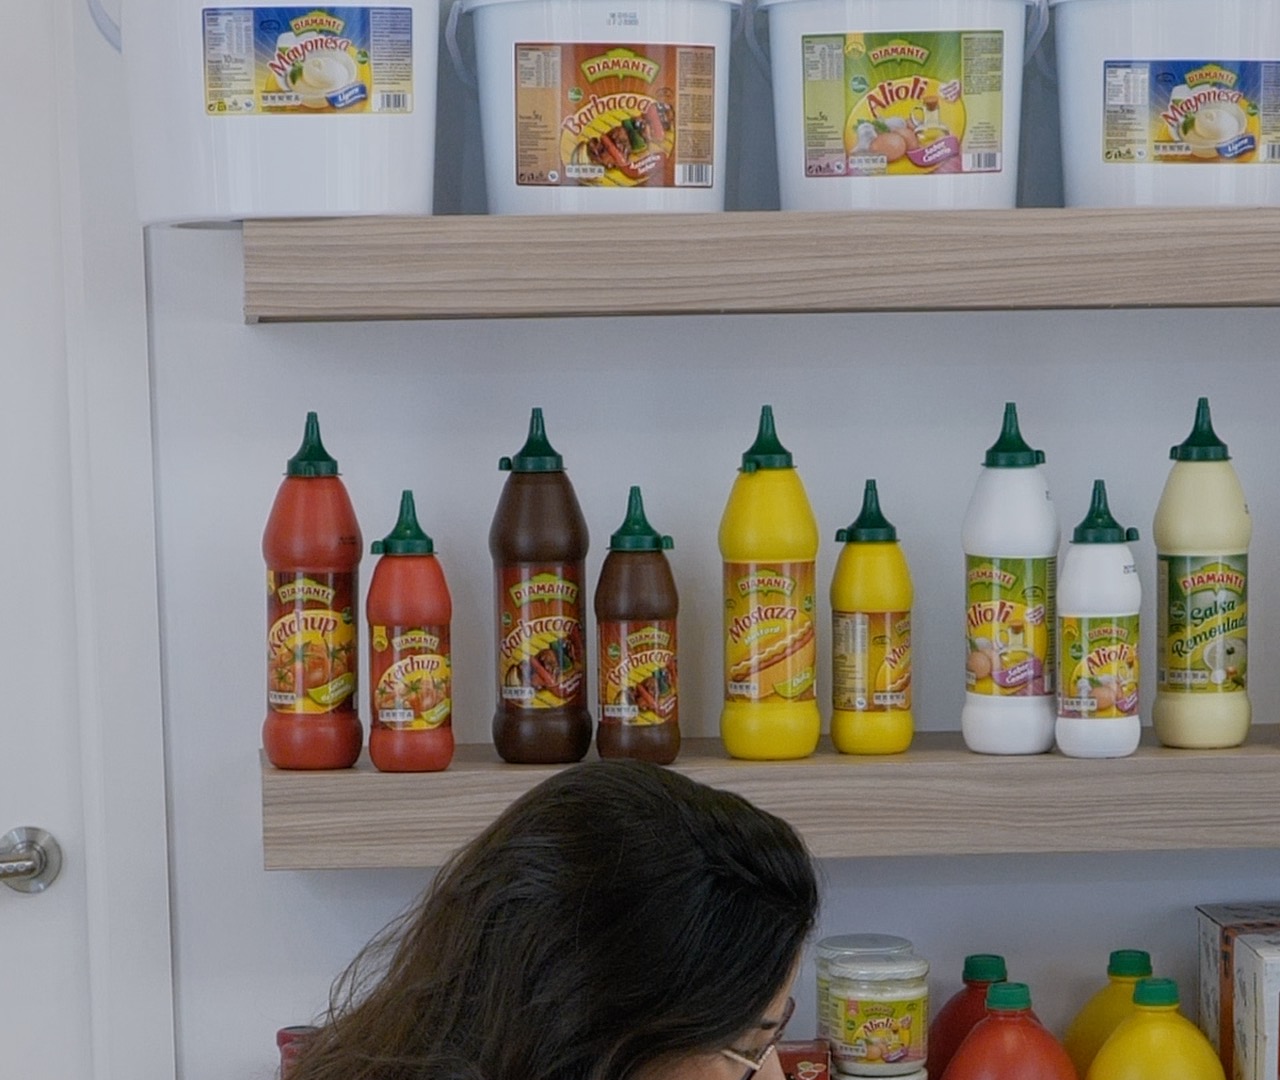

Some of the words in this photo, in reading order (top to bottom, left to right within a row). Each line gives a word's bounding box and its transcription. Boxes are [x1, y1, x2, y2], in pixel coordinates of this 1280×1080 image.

[294, 17, 342, 31] DIAMANTE
[268, 36, 351, 77] Mayonesa
[587, 59, 654, 76] DIAMANTE
[872, 47, 926, 61] DIAMANTE
[1188, 72, 1234, 84] DIAMANTE
[866, 77, 928, 120] Alioli
[1162, 89, 1243, 127] Mayonesa
[563, 94, 650, 136] Barbacoa
[281, 586, 332, 599] DIAMANTE
[515, 583, 576, 600] DIAMANTE
[740, 577, 792, 591] DIAMANTE
[1183, 572, 1244, 589] DIAMANTE
[728, 606, 797, 643] Mostaza
[1190, 600, 1235, 627] Salsa
[270, 611, 337, 656] Ketchup
[501, 617, 575, 659] Barbacoa
[630, 634, 668, 645] DIAMANTE
[383, 655, 439, 690] Ketchup
[609, 652, 670, 685] Barbacoa
[1086, 644, 1130, 675] Alioli
[863, 1017, 895, 1037] Alioli
